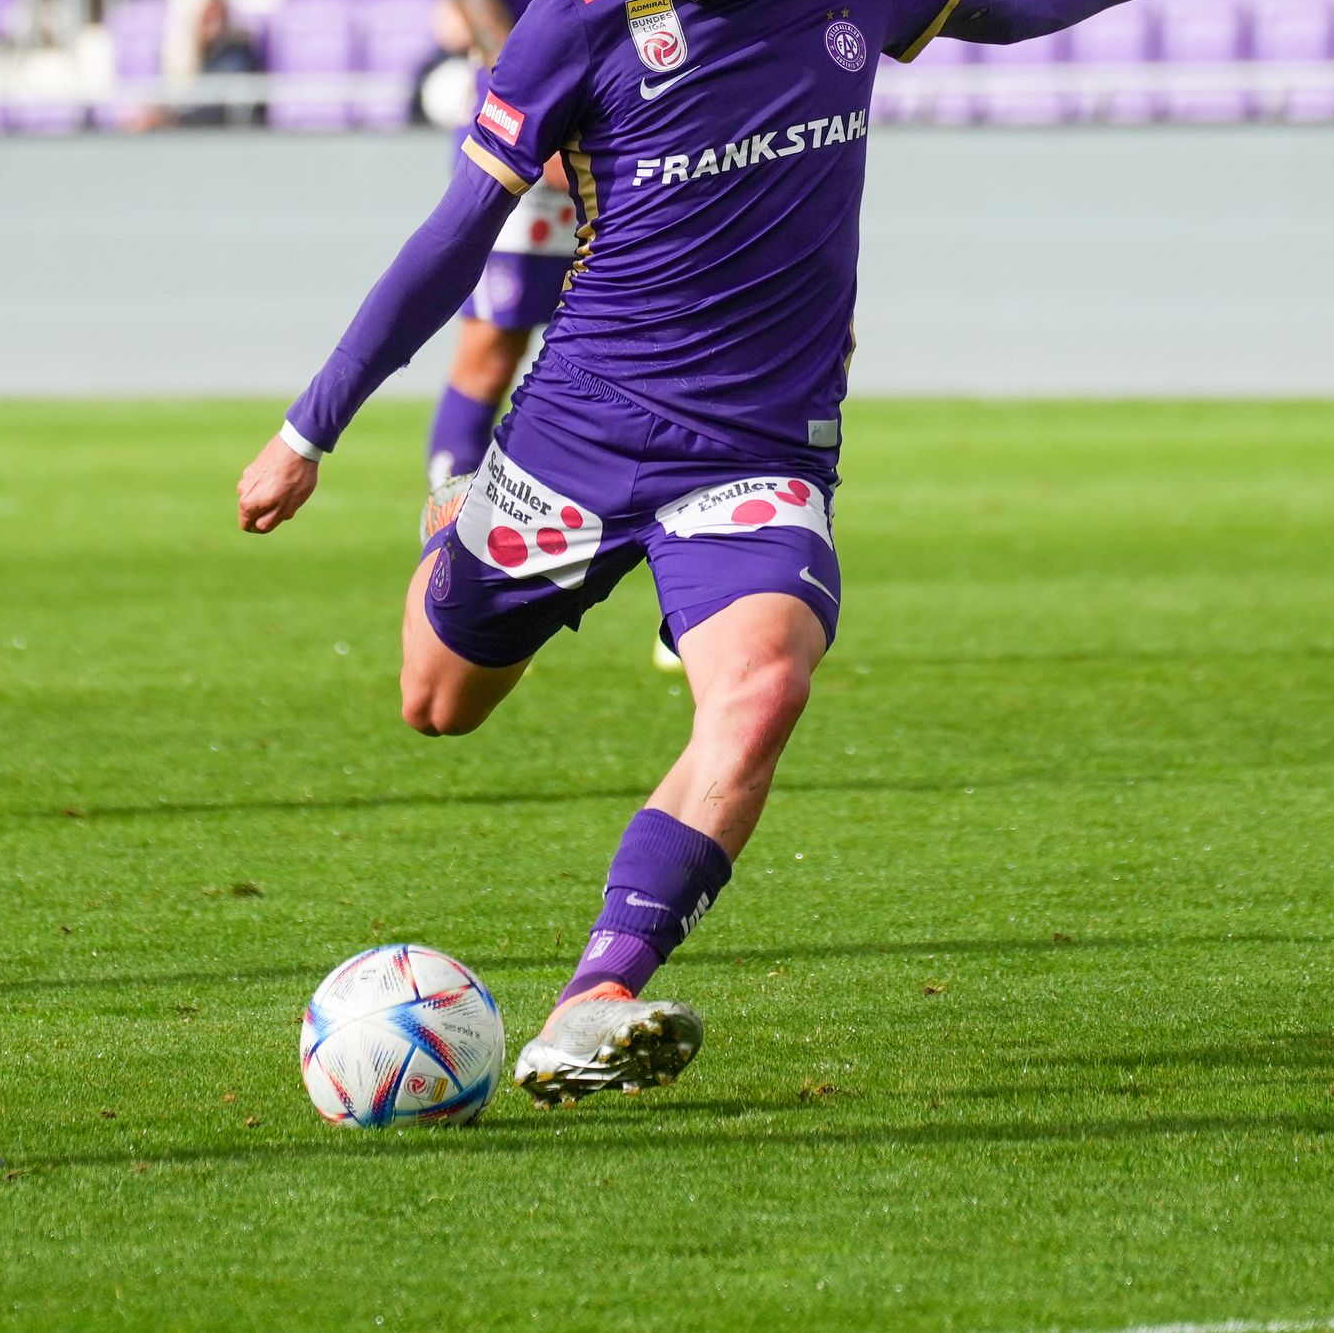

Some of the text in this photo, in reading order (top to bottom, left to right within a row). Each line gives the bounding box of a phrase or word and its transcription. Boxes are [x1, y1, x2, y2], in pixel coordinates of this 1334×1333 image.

[630, 0, 669, 14] ADMIRAL
[631, 12, 673, 29] BUNDES
[643, 22, 667, 33] LIGA
[632, 108, 867, 187] FRANKSTAHL
[487, 450, 552, 516] Schuller
